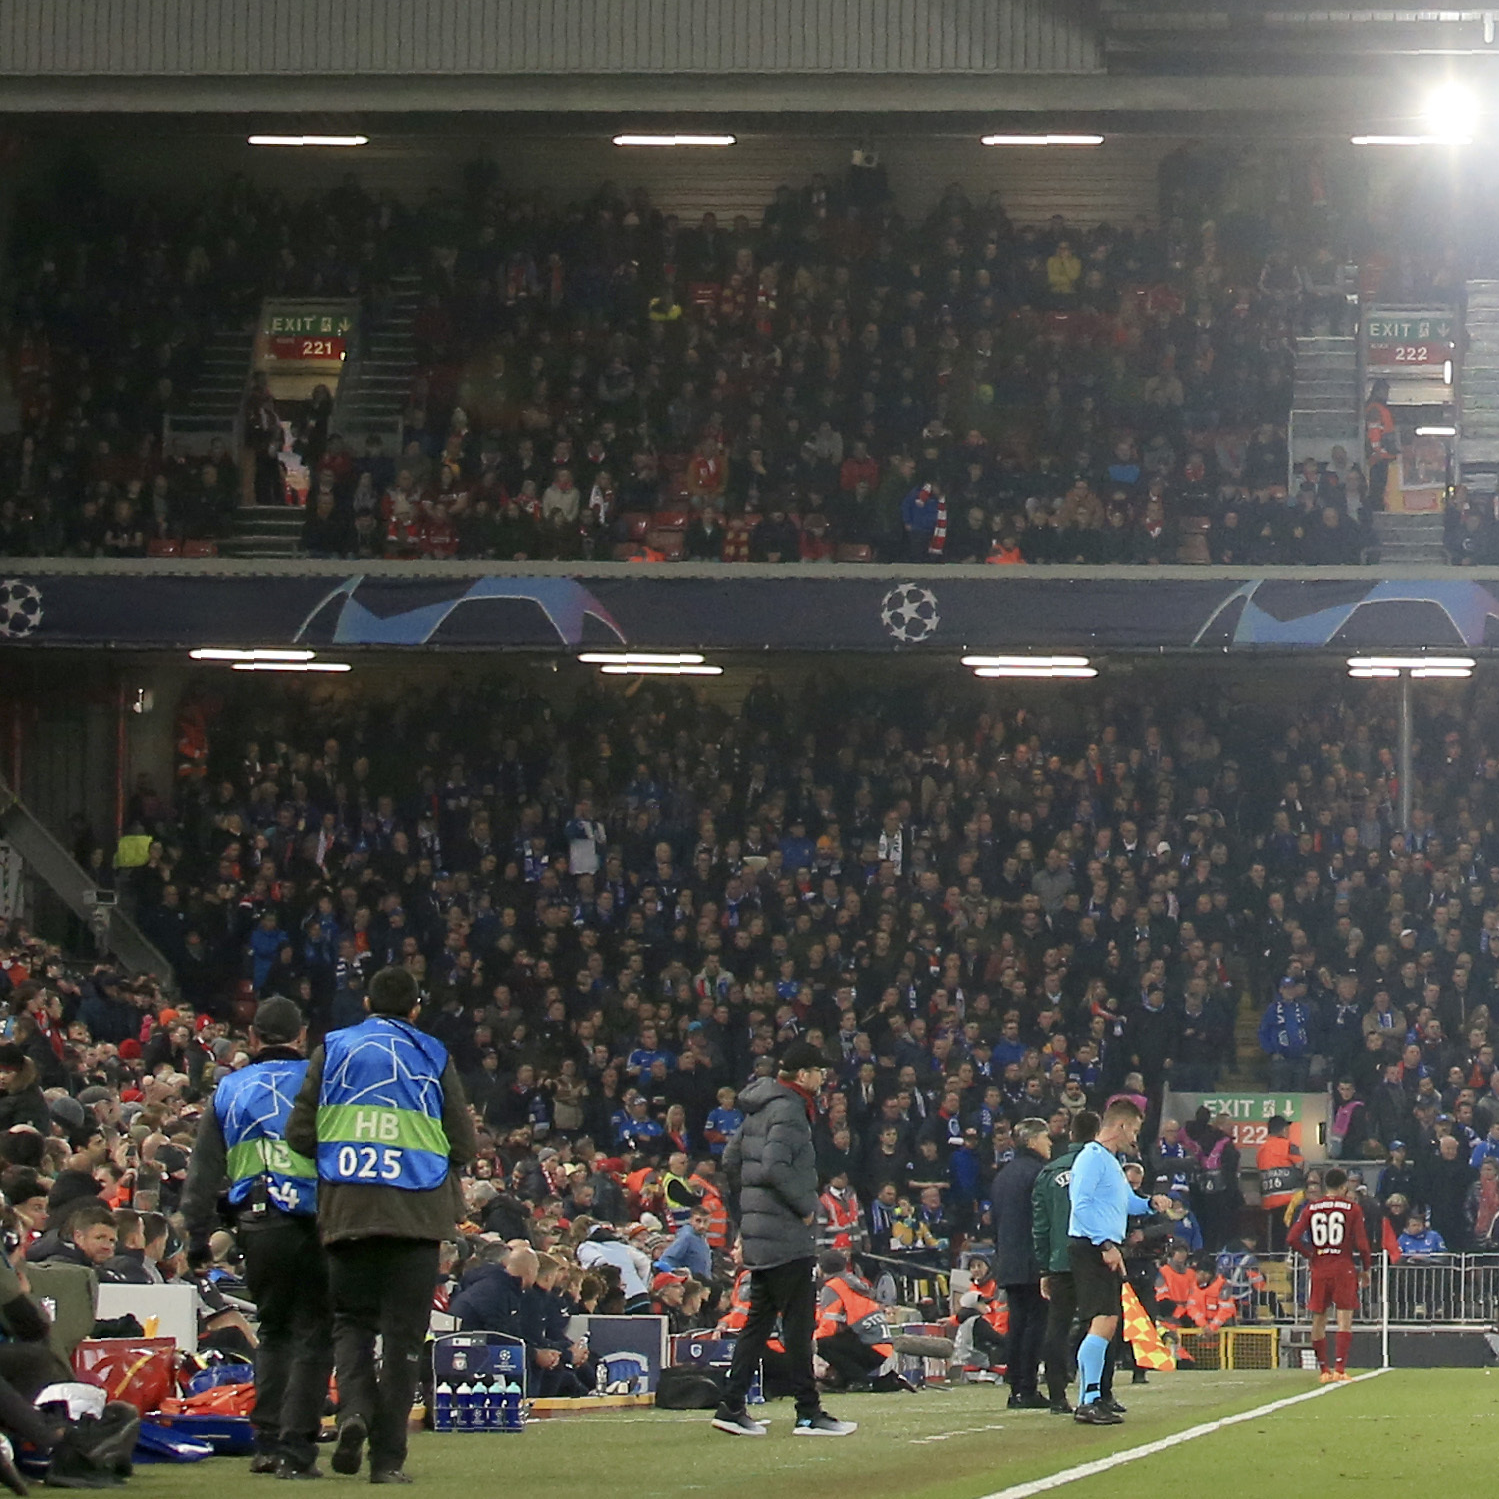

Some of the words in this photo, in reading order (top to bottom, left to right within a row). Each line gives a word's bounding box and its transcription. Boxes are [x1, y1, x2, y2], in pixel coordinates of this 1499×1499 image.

[271, 316, 314, 332] EXIT
[1369, 322, 1412, 338] EXIT
[303, 341, 333, 355] 221
[1395, 346, 1428, 361] 222
[1203, 1099, 1255, 1118] EXIT
[354, 1111, 400, 1141] HB
[338, 1146, 403, 1180] 025
[1310, 1210, 1346, 1247] 66
